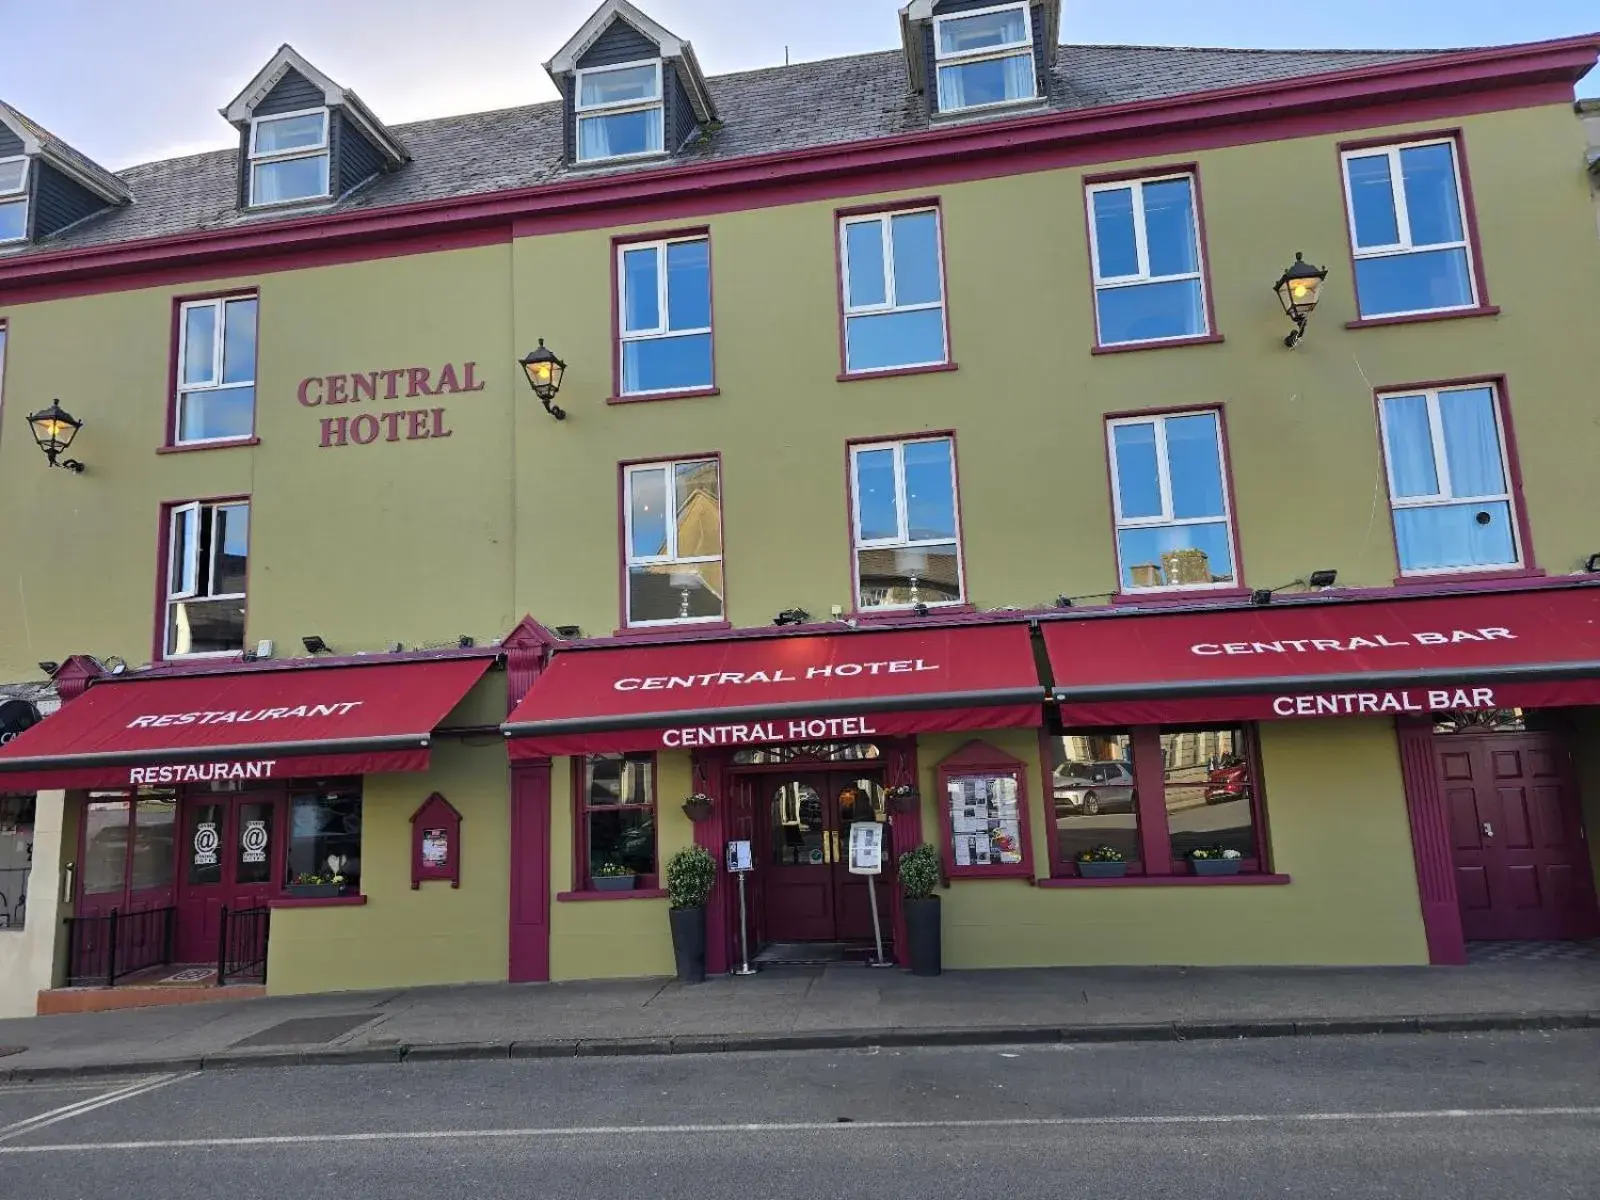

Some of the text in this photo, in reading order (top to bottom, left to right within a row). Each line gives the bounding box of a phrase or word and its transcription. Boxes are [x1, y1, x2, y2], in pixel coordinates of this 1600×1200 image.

[297, 361, 485, 407] CENTRAL
[318, 407, 452, 447] HOTEL
[1191, 627, 1518, 655] CENTRAL BAR
[614, 659, 940, 691] CENTRAL HOTEL
[127, 701, 363, 728] RESTAURANT
[1273, 687, 1496, 716] CENTRAL BAR
[662, 716, 876, 747] CENTRAL HOTEL
[130, 760, 276, 784] RESTAURANT
